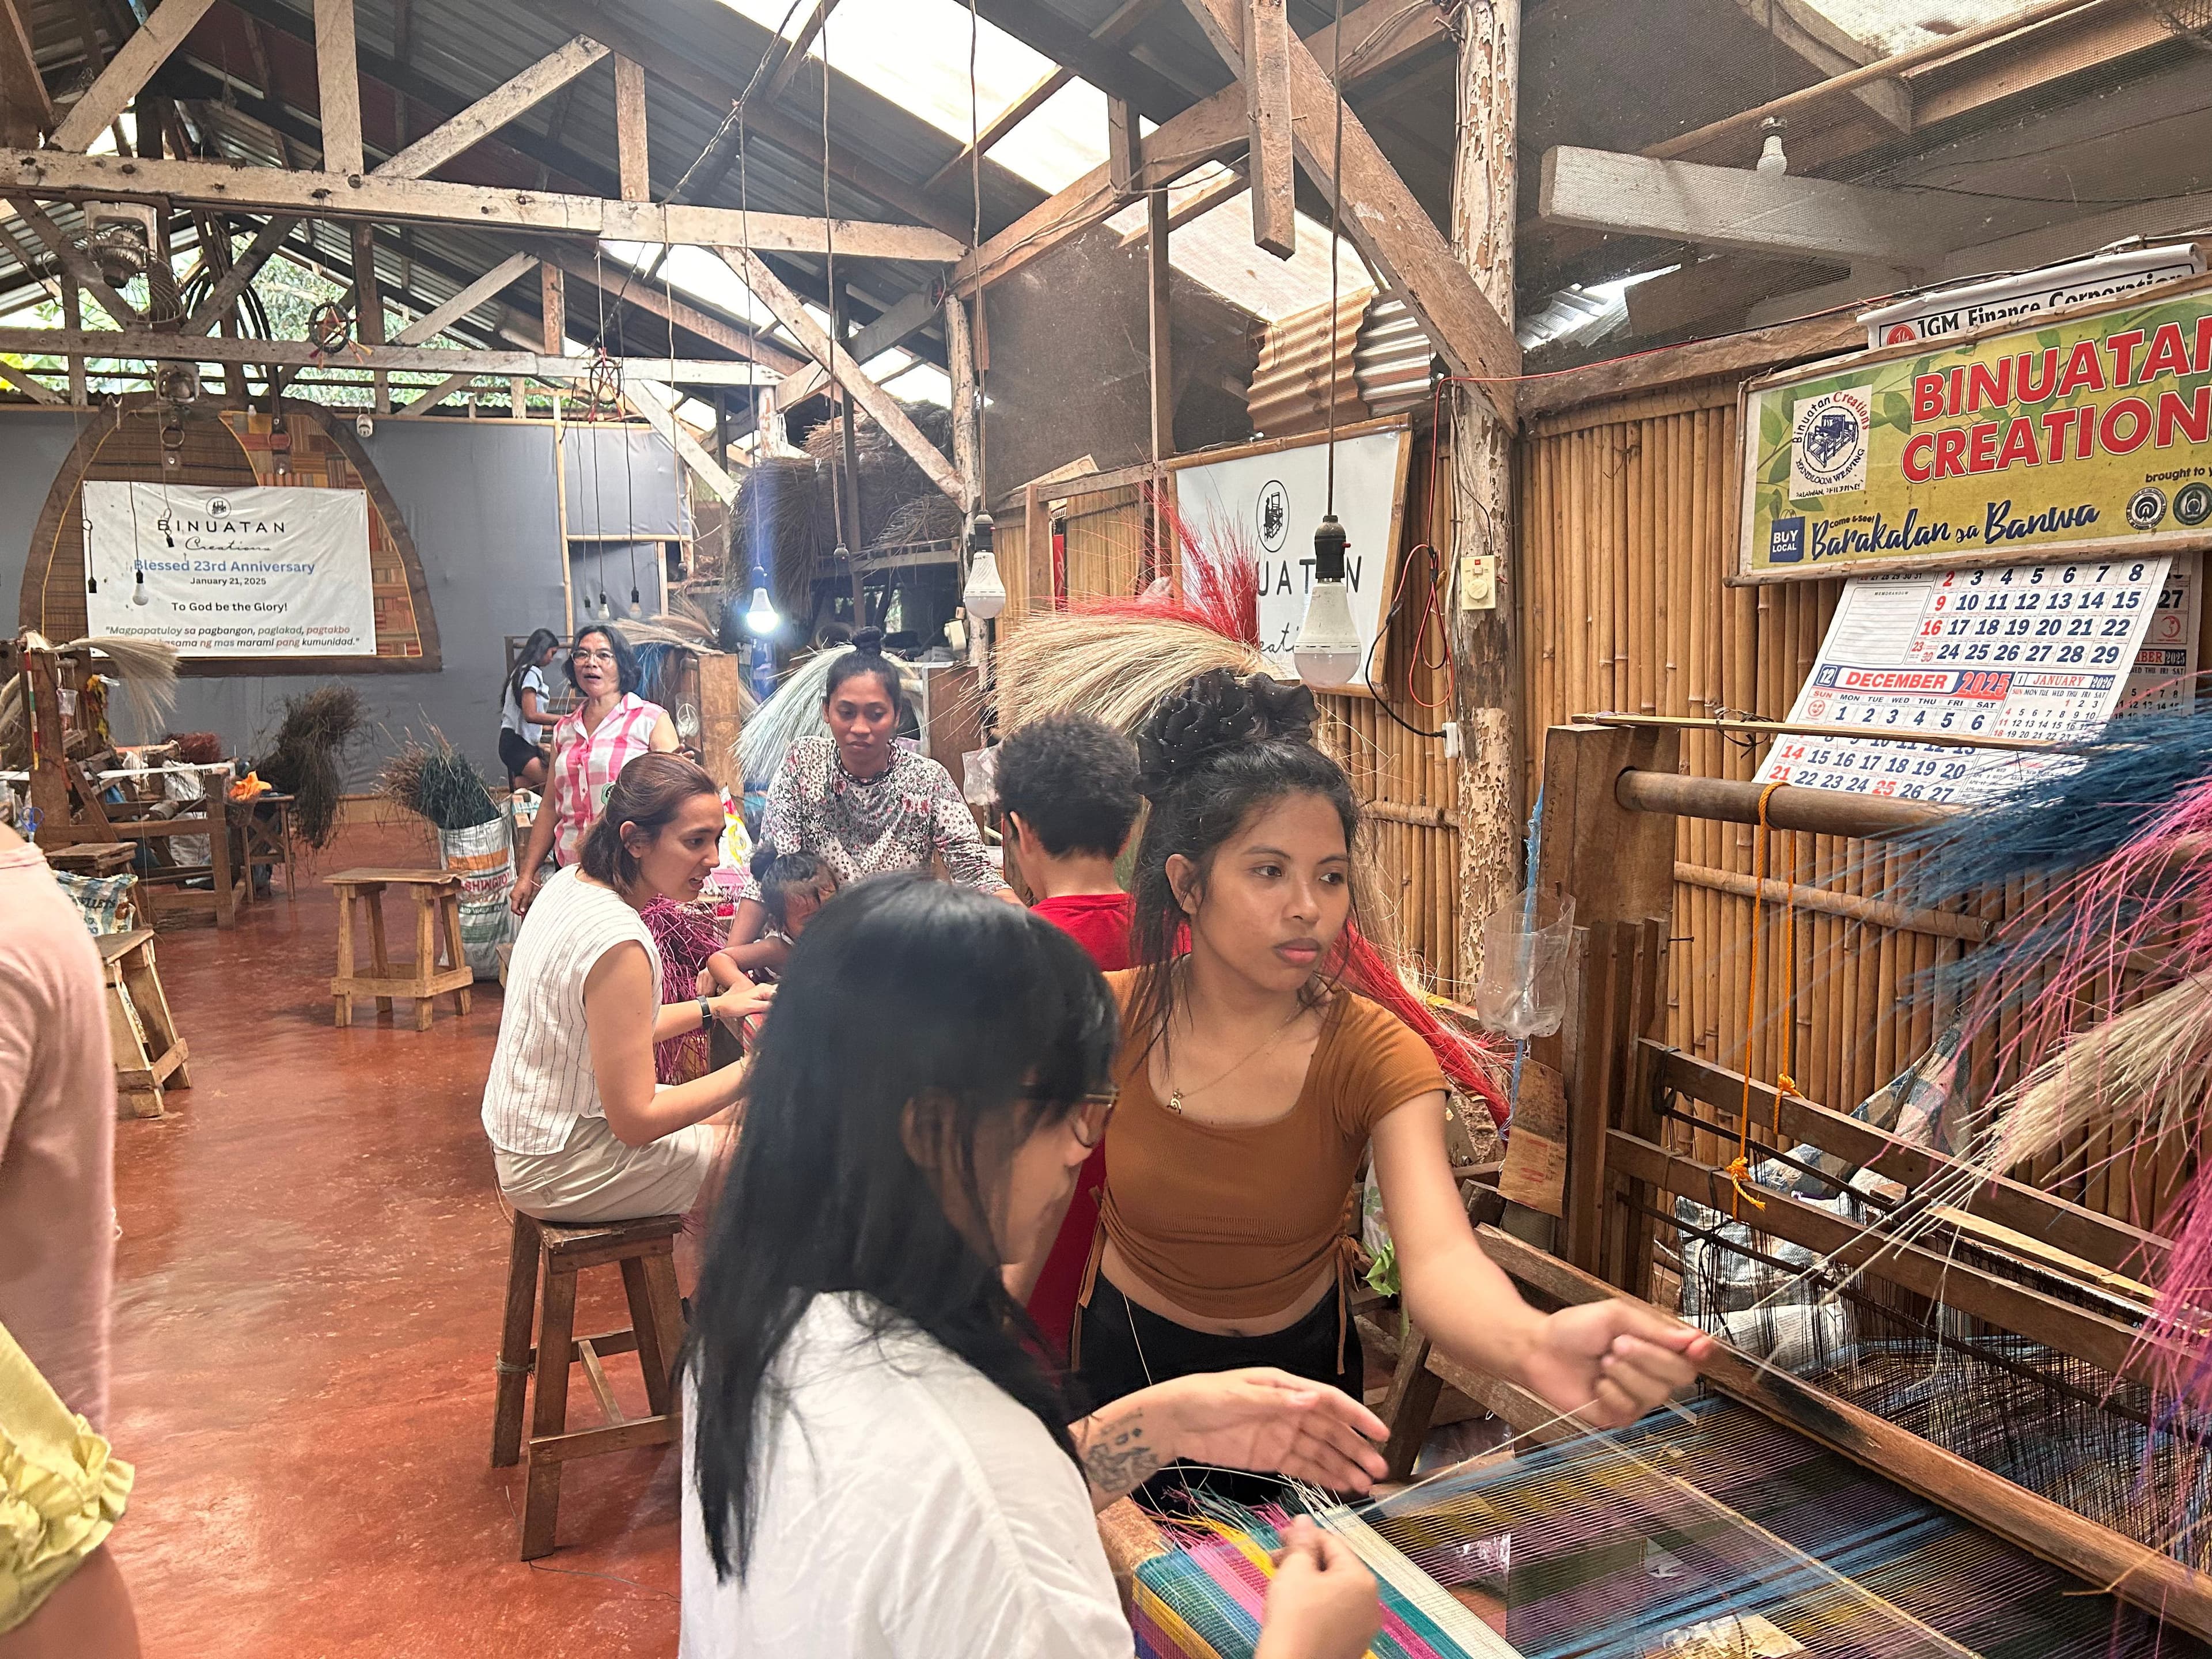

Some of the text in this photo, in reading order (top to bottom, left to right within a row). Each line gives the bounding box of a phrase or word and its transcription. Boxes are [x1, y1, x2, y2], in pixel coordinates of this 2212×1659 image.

[1792, 391, 1870, 443] Binuatan Creations
[1796, 449, 1865, 484] HANDLOOM WEAVING
[2145, 468, 2191, 483] brought
[2194, 467, 2206, 476] to
[157, 520, 285, 533] BINUATAN
[1812, 508, 1951, 560] Barakalan
[1957, 527, 1979, 543] sa
[1986, 499, 2101, 545] Banwa
[1830, 517, 1851, 528] come
[185, 536, 272, 551] Creations
[1773, 530, 1798, 544] BUY
[1772, 544, 1797, 553] LOCAL
[134, 560, 315, 575] Blessed 23rd Anniversary
[1943, 564, 2143, 586] 2 3 4 5 6 7 8
[190, 577, 227, 586] January
[229, 578, 242, 586] 21,
[1935, 592, 2141, 611] 9 10 11 12 13 14 15
[2158, 590, 2183, 608] 27
[172, 602, 287, 613] To God be the Glory!
[198, 626, 255, 636] pagbangon,
[258, 626, 304, 636] paglakad,
[306, 626, 350, 635] pagtakbo
[1921, 619, 2130, 635] 16 17 18 19 20 21 22
[237, 638, 275, 646] marami
[276, 639, 300, 648] pang
[1911, 641, 1924, 652] 23
[1937, 644, 1959, 660] 24
[1965, 644, 1990, 660] 25
[1994, 645, 2020, 660] 26
[2025, 646, 2052, 661] 27
[2057, 646, 2085, 662] 28
[2090, 646, 2119, 663] 29
[2166, 653, 2185, 664] 2025
[1819, 668, 2012, 697] 12 DECEMBER 2025
[2033, 675, 2085, 686] JANUARY
[2092, 677, 2113, 689] 2026
[1836, 706, 1984, 730] 1 2 3 4 5 6
[1781, 745, 1966, 779] 14 15 16 17 18 19 20
[1769, 766, 1955, 802] 21 22 23 24 25 26 27
